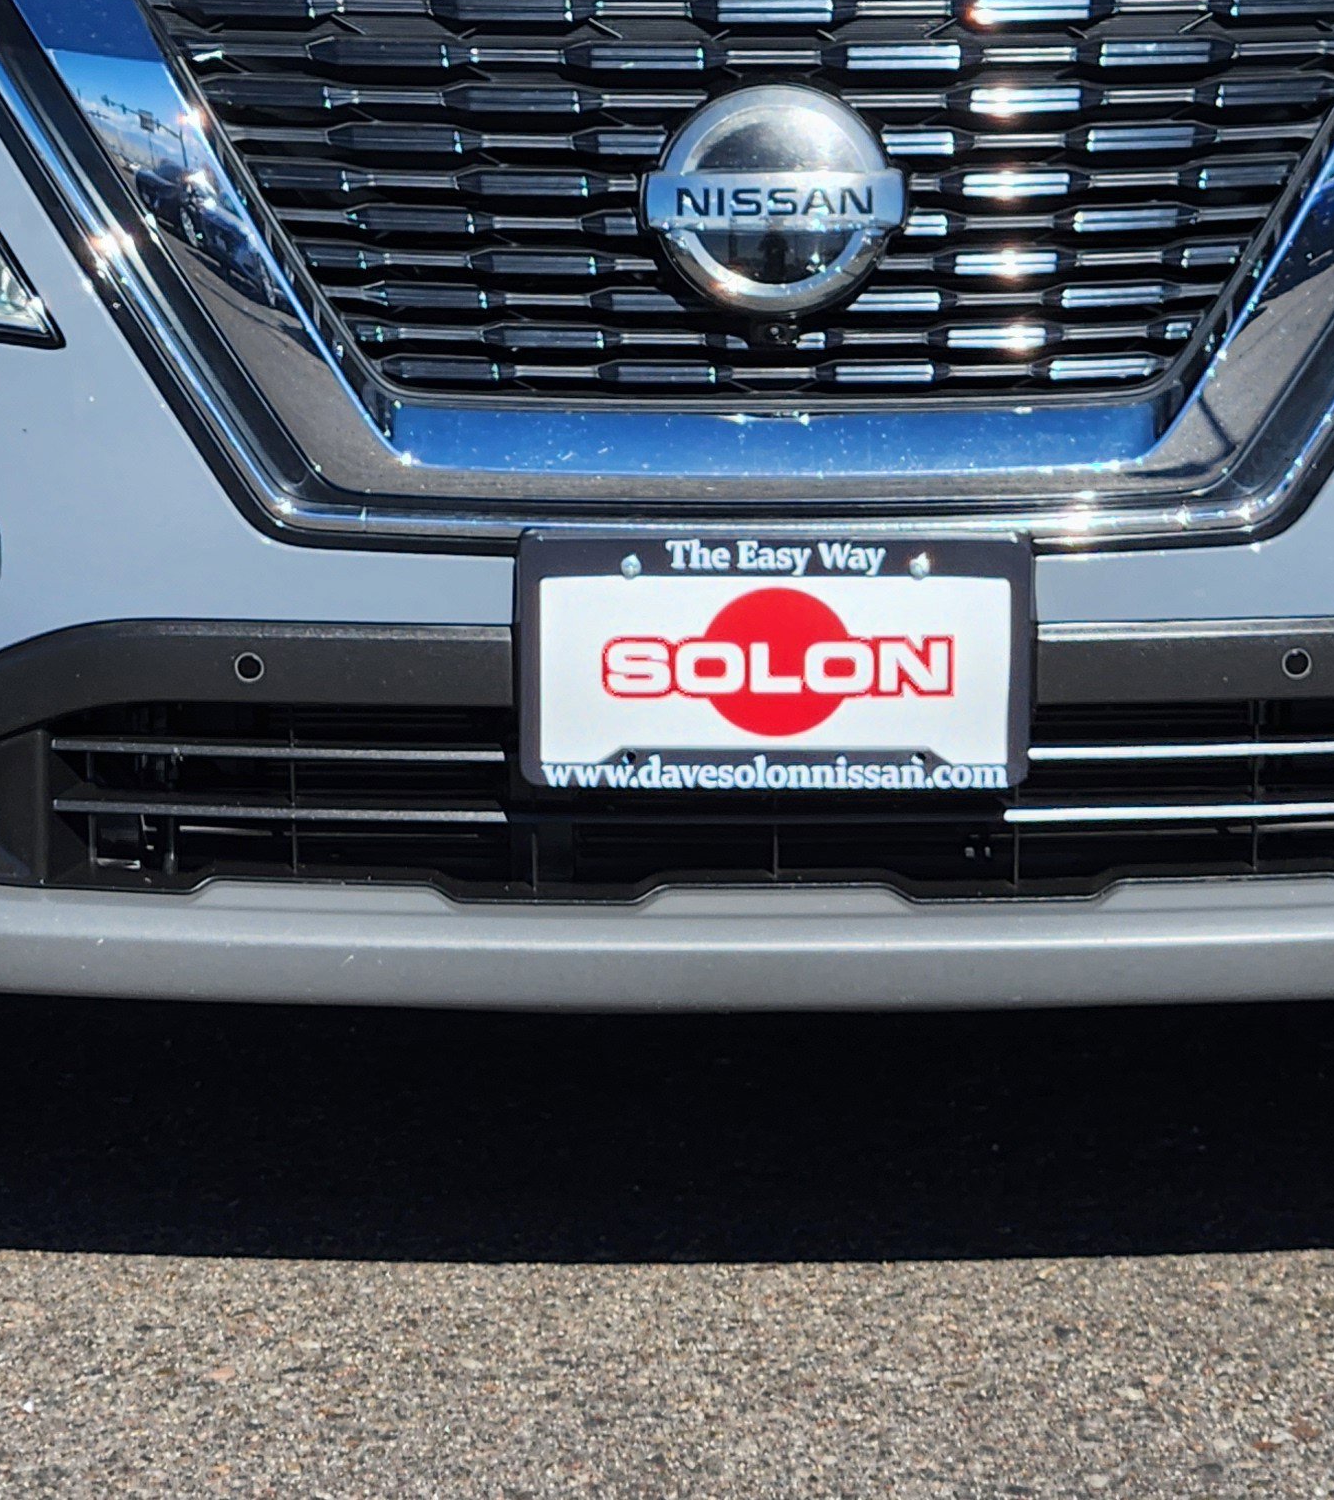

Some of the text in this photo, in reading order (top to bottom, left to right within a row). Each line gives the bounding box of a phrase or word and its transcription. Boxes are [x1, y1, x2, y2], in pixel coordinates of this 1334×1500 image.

[676, 187, 873, 216] NISSAN
[665, 538, 886, 576] The Easy Way
[602, 635, 955, 698] SOLON
[541, 754, 1008, 790] www.davesolonnissan.com
